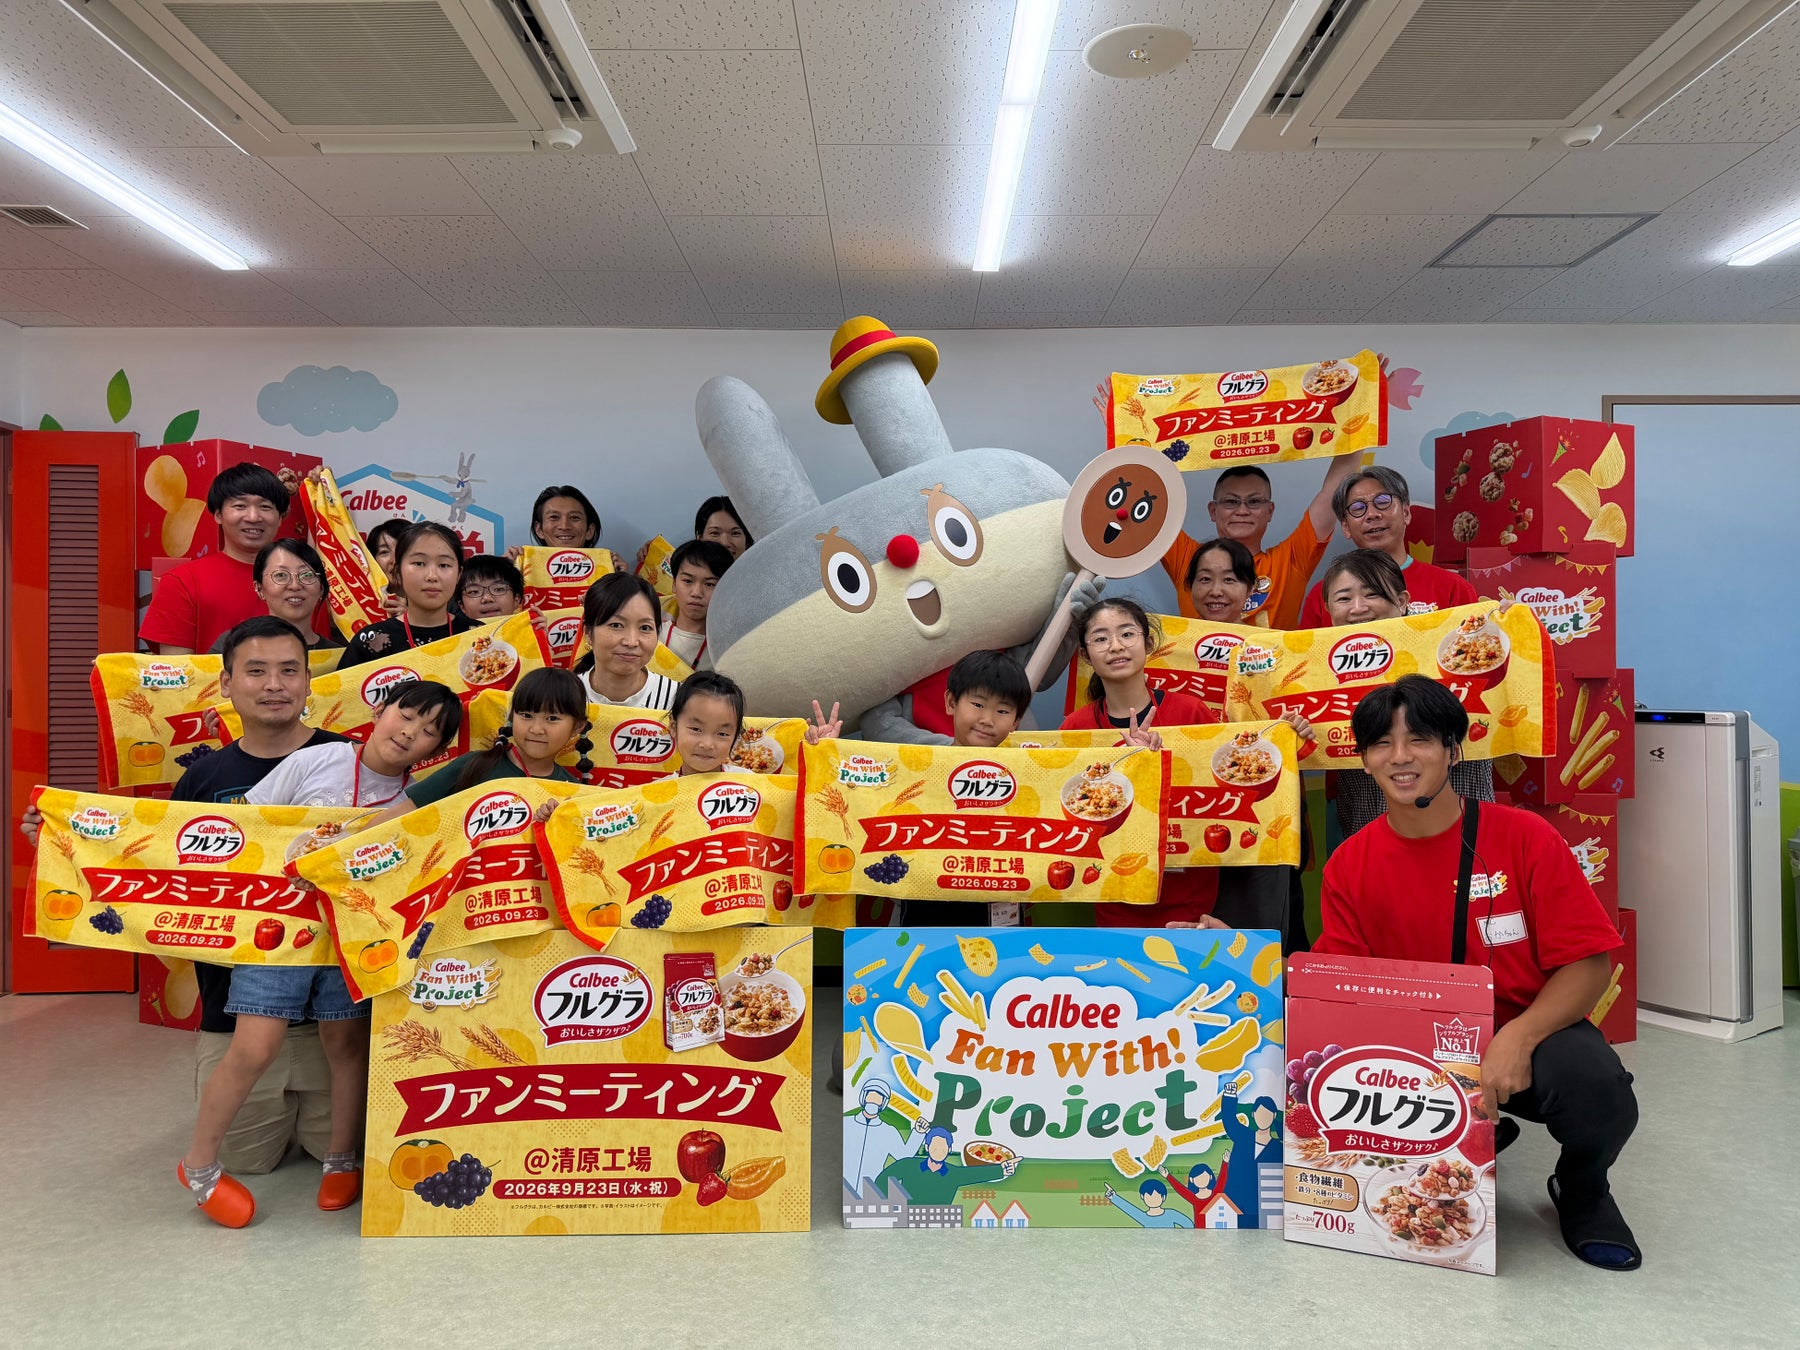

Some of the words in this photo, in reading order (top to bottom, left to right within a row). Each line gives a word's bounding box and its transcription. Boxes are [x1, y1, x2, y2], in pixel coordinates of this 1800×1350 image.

[1231, 373, 1253, 381] Calbee
[1221, 379, 1265, 395] フルグラ
[1164, 400, 1328, 436] ファンミーティング
[1214, 429, 1276, 447] @清原工場
[1220, 446, 1270, 457] 2026.09.23
[559, 555, 581, 563] Calbee
[551, 563, 592, 575] フルグラ
[1521, 593, 1559, 603] Calbee
[1535, 601, 1580, 617] With!
[1345, 641, 1374, 652] Calbee
[1334, 649, 1389, 671] フルグラ
[142, 675, 186, 686] Project
[375, 672, 401, 686] Calbee
[629, 727, 658, 737] Calbee
[617, 735, 673, 755] フルグラ
[843, 763, 859, 772] Fan
[852, 757, 873, 765] Calbee
[840, 771, 887, 783] Project
[967, 769, 997, 779] Calbee
[715, 788, 745, 797] Calbee
[954, 778, 1013, 797] フルグラ
[86, 809, 108, 818] Calbee
[479, 798, 510, 816] Calbee
[595, 806, 617, 817] Calbee
[704, 795, 757, 817] フルグラ
[71, 820, 117, 836] Project
[469, 807, 527, 837] フルグラ
[586, 815, 636, 838] Project
[587, 817, 604, 825] Fan
[197, 824, 227, 835] Calbee
[875, 818, 1094, 853] ファンミーティング
[182, 834, 241, 853] フルグラ
[356, 844, 379, 858] Calbee
[349, 857, 369, 868] Fan
[350, 849, 403, 879] Project
[942, 855, 1025, 874] @清原工場
[951, 877, 1017, 889] 2026.09.23
[465, 886, 543, 912] @清原工場
[154, 911, 236, 932] @清原工場
[473, 908, 539, 927] 2026.09.23
[157, 933, 224, 946] 2026.09.23
[435, 962, 466, 972] Calbee
[420, 971, 443, 984] Fan
[445, 971, 482, 985] With!
[569, 972, 619, 988] Calbee
[413, 981, 484, 1000] Project
[680, 989, 713, 1004] フルグラ
[546, 990, 645, 1021] フルグラ
[1006, 993, 1121, 1030] Calbee
[945, 1028, 1036, 1077] Fan
[1049, 1027, 1187, 1079] With!
[1441, 1037, 1472, 1053] No.1
[1355, 1066, 1421, 1091] Calbee
[420, 1072, 763, 1123] ファンミーティング
[930, 1069, 1198, 1139] Project
[1326, 1086, 1456, 1133] フルグラ
[524, 1146, 652, 1175] @清原工場
[504, 1181, 669, 1196] 2026年9月23日（水・祝）
